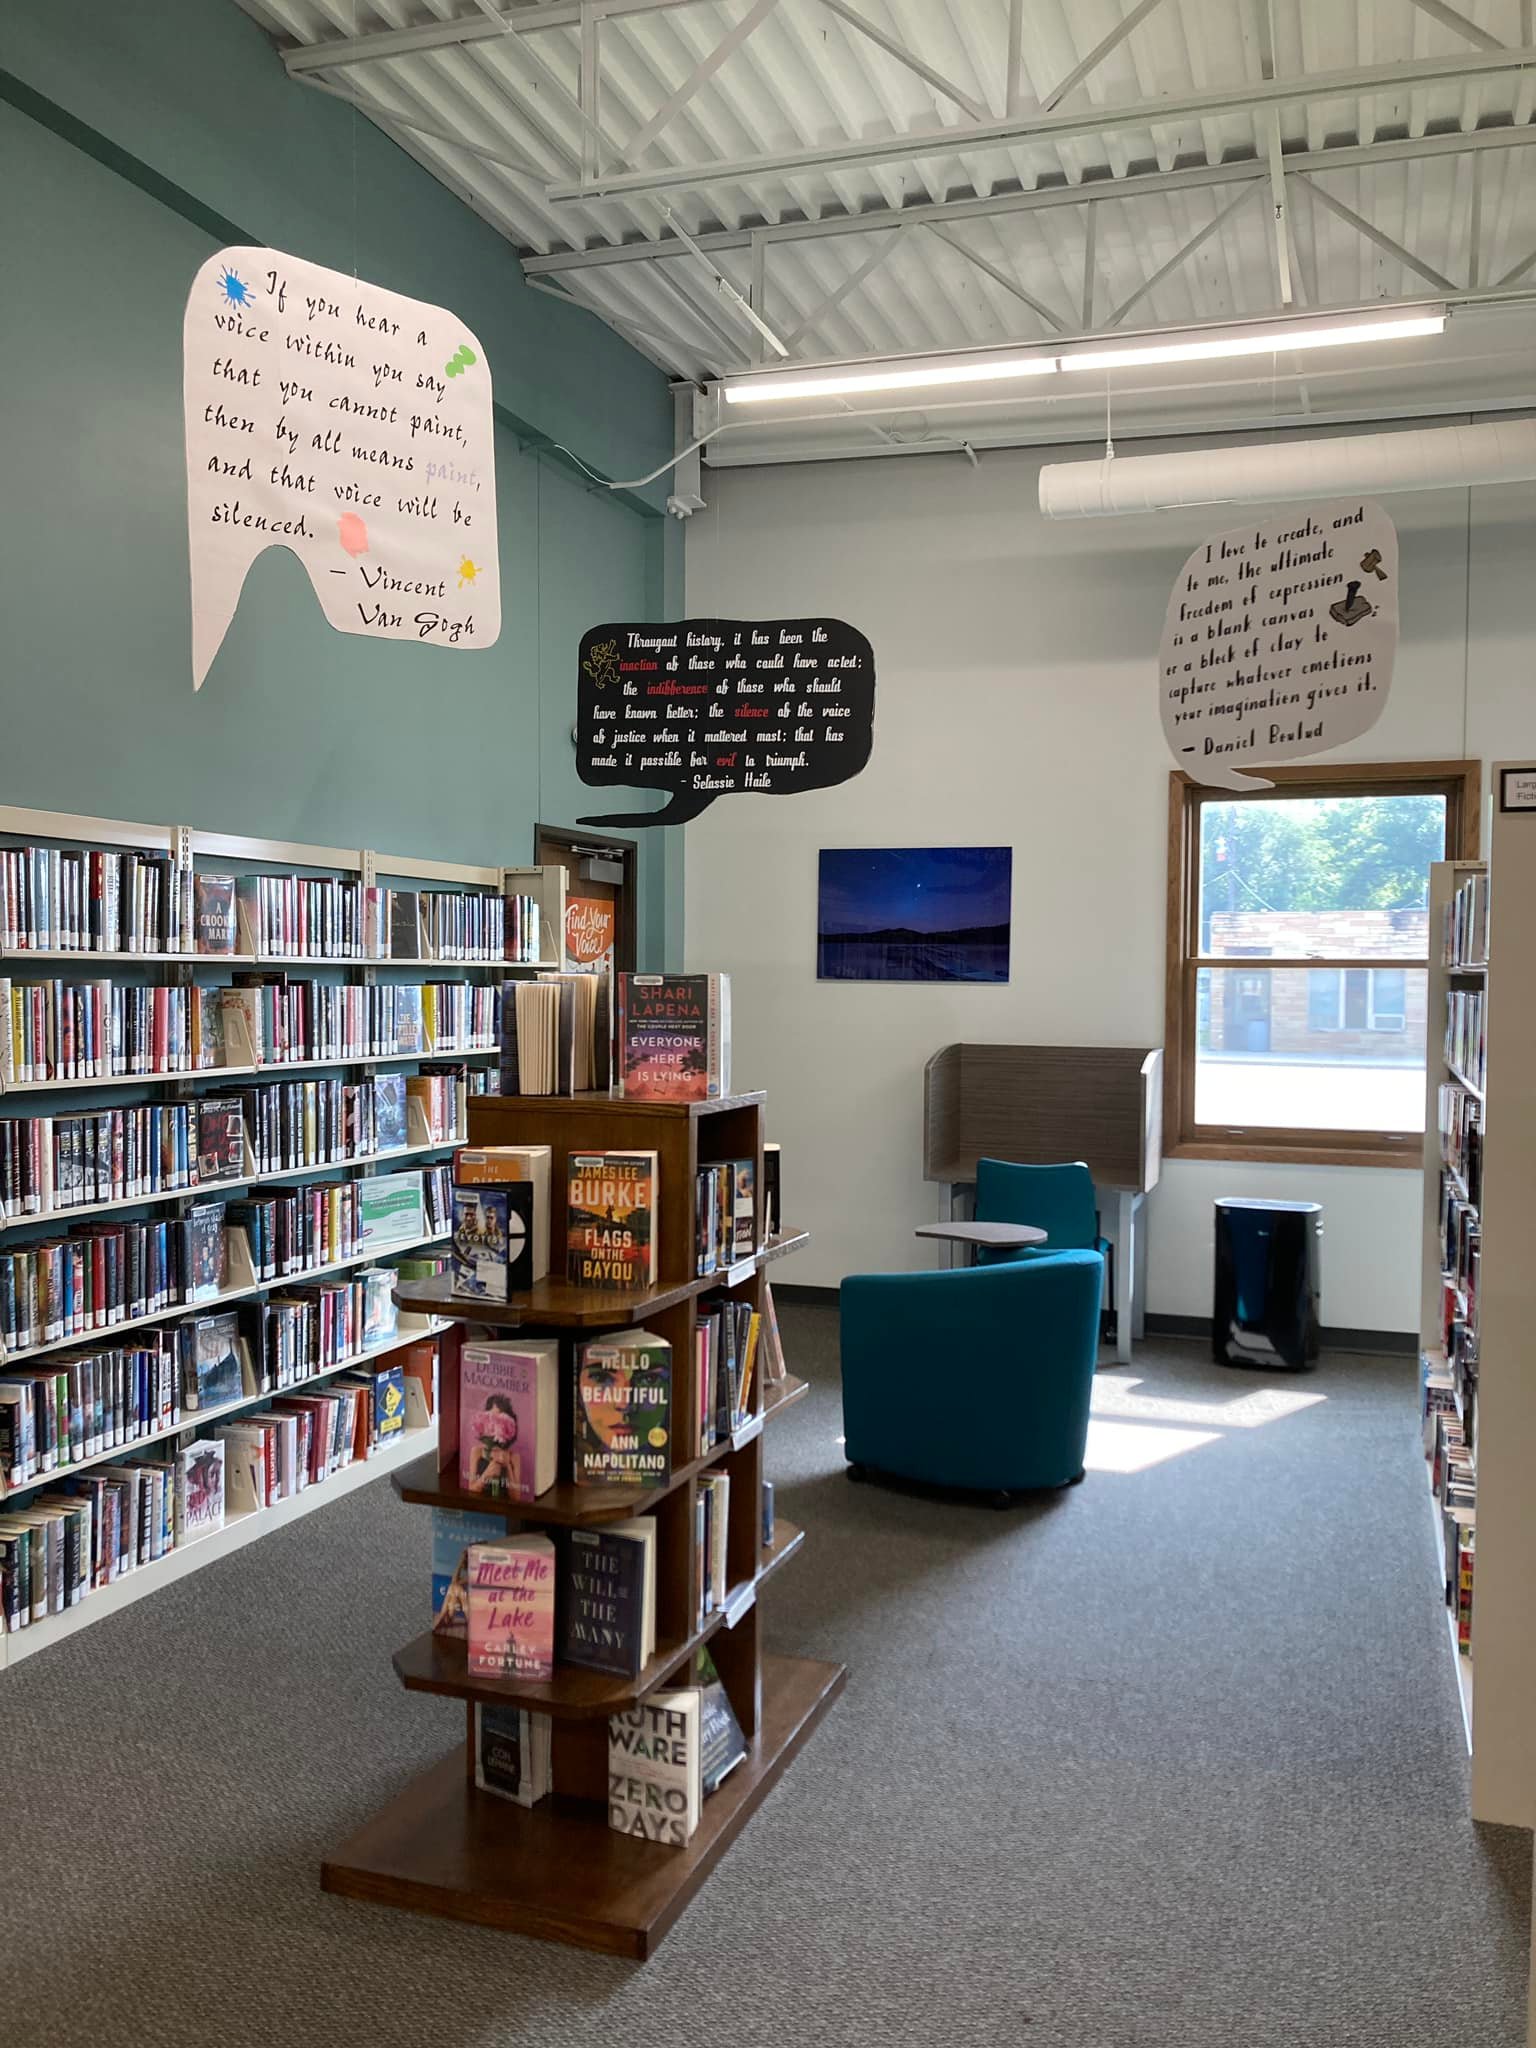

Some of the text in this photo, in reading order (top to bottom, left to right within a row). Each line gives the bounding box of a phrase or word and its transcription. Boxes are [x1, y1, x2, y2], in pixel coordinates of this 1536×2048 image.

[266, 271, 428, 346] If you hear a
[214, 313, 446, 403] voice within you say
[213, 358, 468, 448] that you cannot paint,
[204, 404, 480, 491] then by all means paint,
[208, 455, 472, 527] and that voice will be
[211, 501, 314, 539] silenced.
[1205, 507, 1364, 563] I love to create, and
[1187, 574, 1199, 592] to
[1238, 562, 1262, 581] the
[1270, 541, 1335, 573] ultimate
[359, 565, 448, 598] Vincent
[1180, 573, 1344, 622] freedom of expression
[357, 602, 475, 643] Van Gogh
[1173, 608, 1315, 646] is a blank canvas
[733, 633, 741, 646] it
[751, 630, 770, 645] has
[779, 629, 803, 644] been
[812, 627, 828, 643] the
[1166, 624, 1329, 676] or a block of clay to
[619, 658, 659, 671] inaction
[666, 655, 679, 671] of
[688, 655, 716, 670] those
[725, 653, 747, 669] who
[756, 653, 784, 669] could
[793, 653, 818, 668] have
[623, 681, 638, 696] the
[716, 678, 729, 695] of
[737, 678, 765, 693] those
[773, 677, 796, 693] who
[806, 677, 842, 693] should
[1168, 650, 1372, 704] capture whatever emotions
[1175, 671, 1377, 726] your imagination gives it.
[593, 705, 617, 720] have
[625, 704, 657, 719] known
[708, 703, 725, 718] the
[734, 702, 769, 718] silence
[777, 701, 791, 718] of
[797, 702, 813, 718] the
[822, 703, 851, 717] voice
[593, 728, 606, 744] of
[611, 729, 646, 749] justice
[653, 728, 679, 743] when
[687, 729, 696, 742] it
[704, 729, 747, 743] mattered
[794, 726, 814, 742] that
[825, 726, 844, 742] has
[1204, 722, 1324, 755] Daniel Boulud
[591, 751, 809, 771] made it possible for evil to triumph.
[693, 772, 772, 790] Selassie Haile
[640, 986, 693, 1000] SHARI
[632, 1003, 701, 1017] LAPENA
[631, 1036, 701, 1048] EVERYONE
[649, 1054, 684, 1065] HERE
[637, 1071, 692, 1082] IS LYING
[577, 1166, 638, 1180] JAMES LEE
[570, 1179, 647, 1209] BURKE
[585, 1229, 632, 1247] FLAGS
[590, 1249, 625, 1262] ON THE
[583, 1260, 633, 1281] BAYOU
[602, 1353, 650, 1369] HELLO
[464, 1371, 530, 1394] MACOMBER
[583, 1385, 668, 1405] BEAUTIFUL
[610, 1435, 639, 1450] ANN
[583, 1453, 665, 1470] NAPOLITANO
[477, 1558, 548, 1583] Meet Me
[582, 1551, 619, 1574] THE
[488, 1585, 536, 1603] at the
[572, 1573, 617, 1599] WILL
[488, 1607, 534, 1630] Lake
[580, 1599, 617, 1623] THE
[573, 1622, 625, 1649] MANY
[484, 1643, 537, 1654] CARLEY
[479, 1656, 542, 1670] FORTUNE
[609, 1724, 688, 1767] WARE
[609, 1773, 688, 1815] ZERO
[609, 1804, 687, 1846] DAYS
